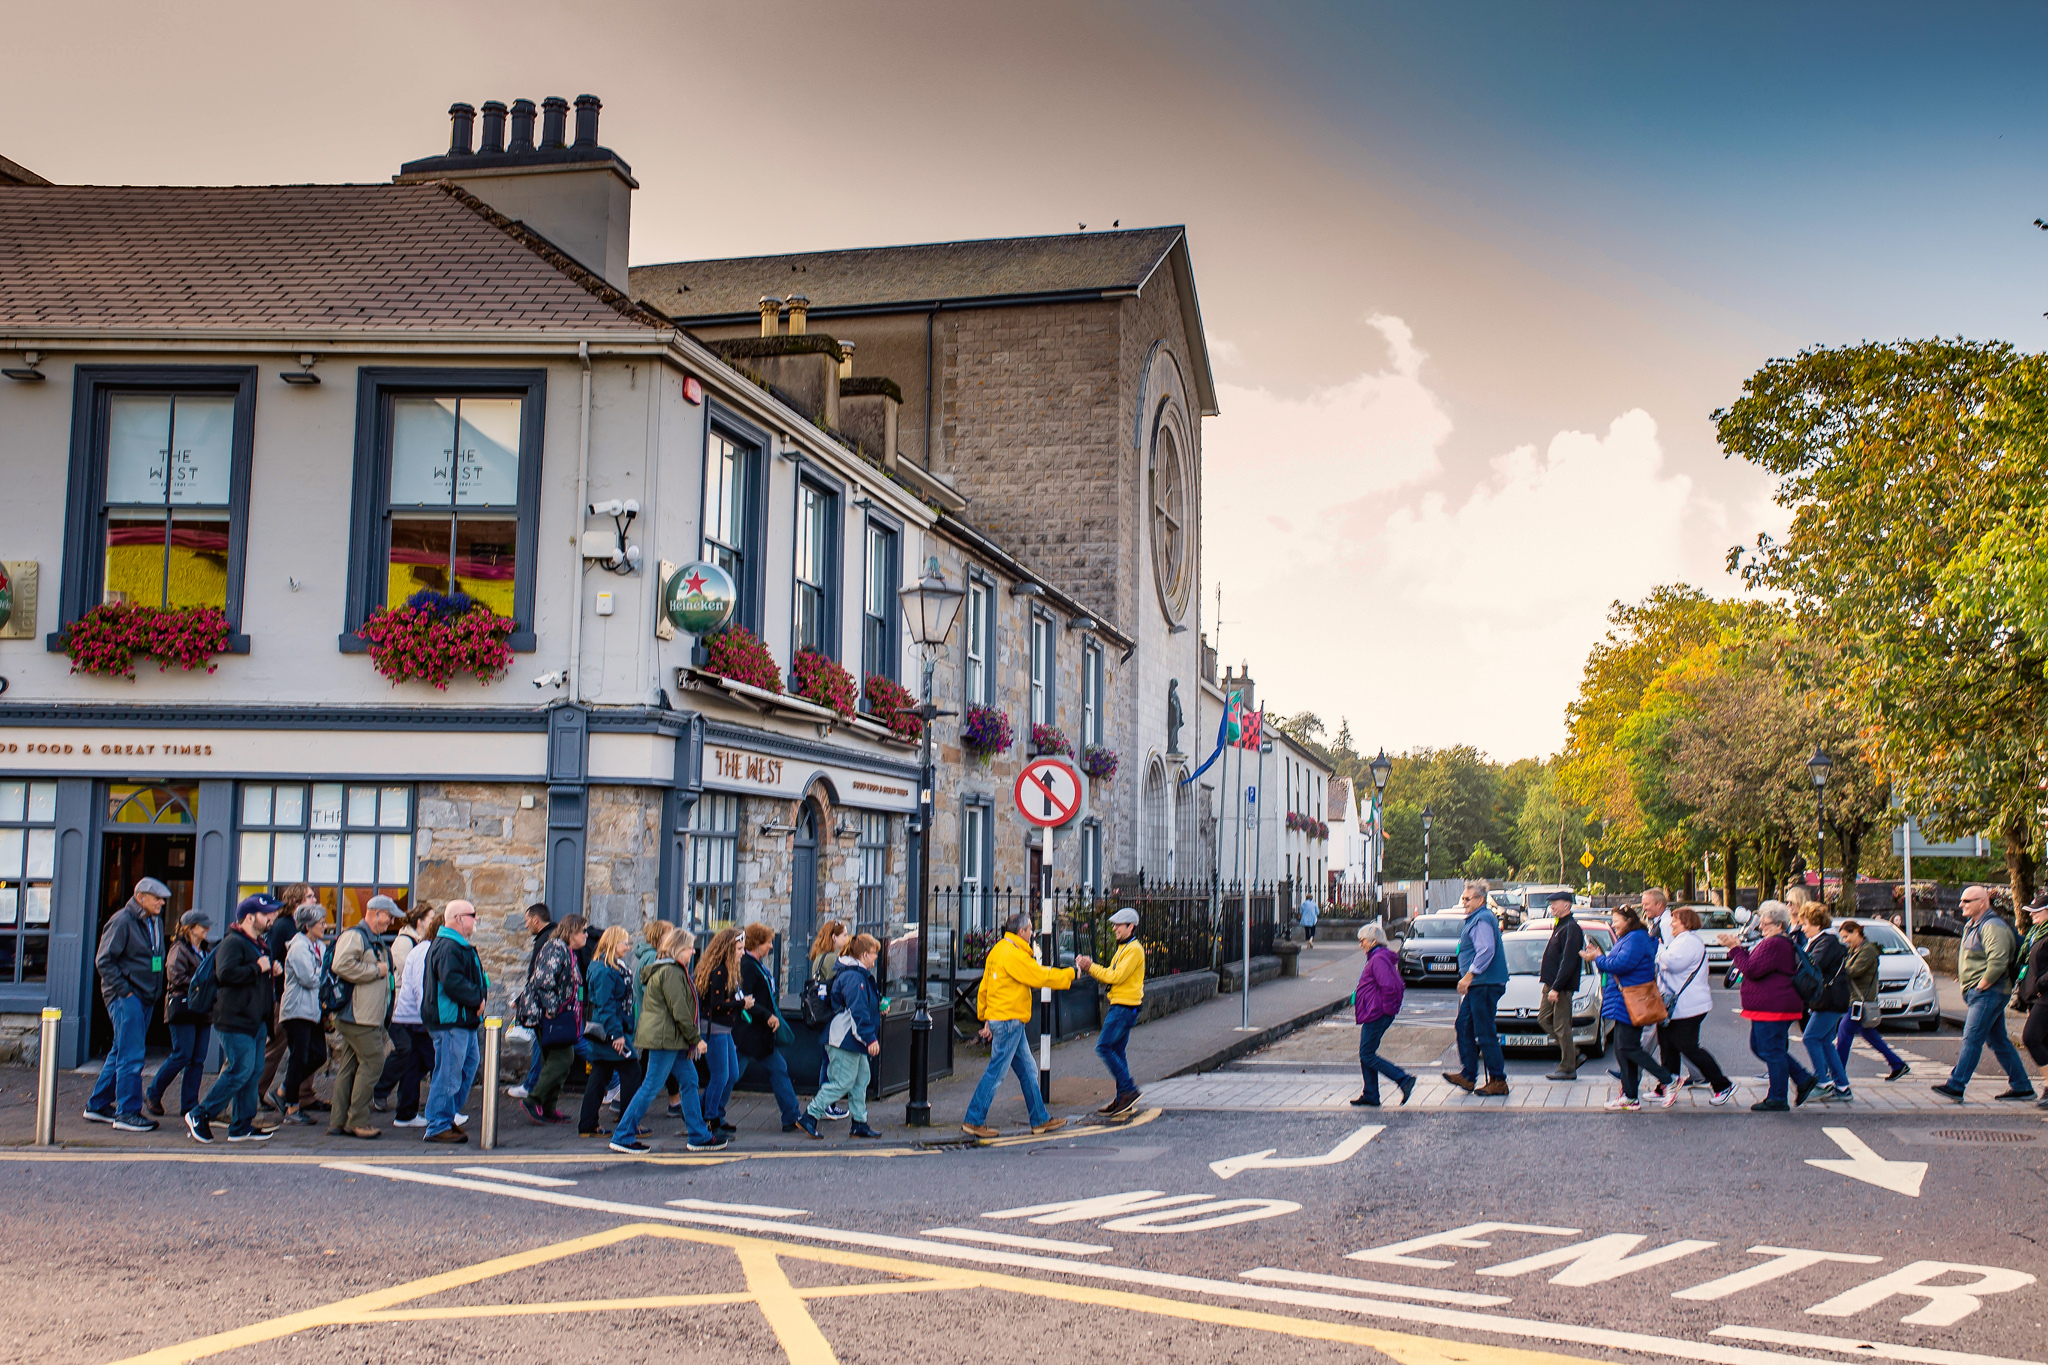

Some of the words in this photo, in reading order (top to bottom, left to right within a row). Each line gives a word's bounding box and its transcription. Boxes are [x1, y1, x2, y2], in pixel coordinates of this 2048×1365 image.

[159, 449, 192, 463] THE
[443, 449, 476, 463] THE
[149, 466, 199, 480] WST
[434, 466, 483, 480] WST
[669, 599, 724, 611] Heineken
[27, 743, 73, 755] FOOD
[82, 744, 92, 755] &
[101, 744, 155, 756] GREAT
[162, 744, 213, 756] TIMES
[716, 750, 744, 780] THE
[747, 755, 784, 785] WEST
[980, 1190, 1303, 1233] NO
[1346, 1222, 2037, 1326] ENTR
